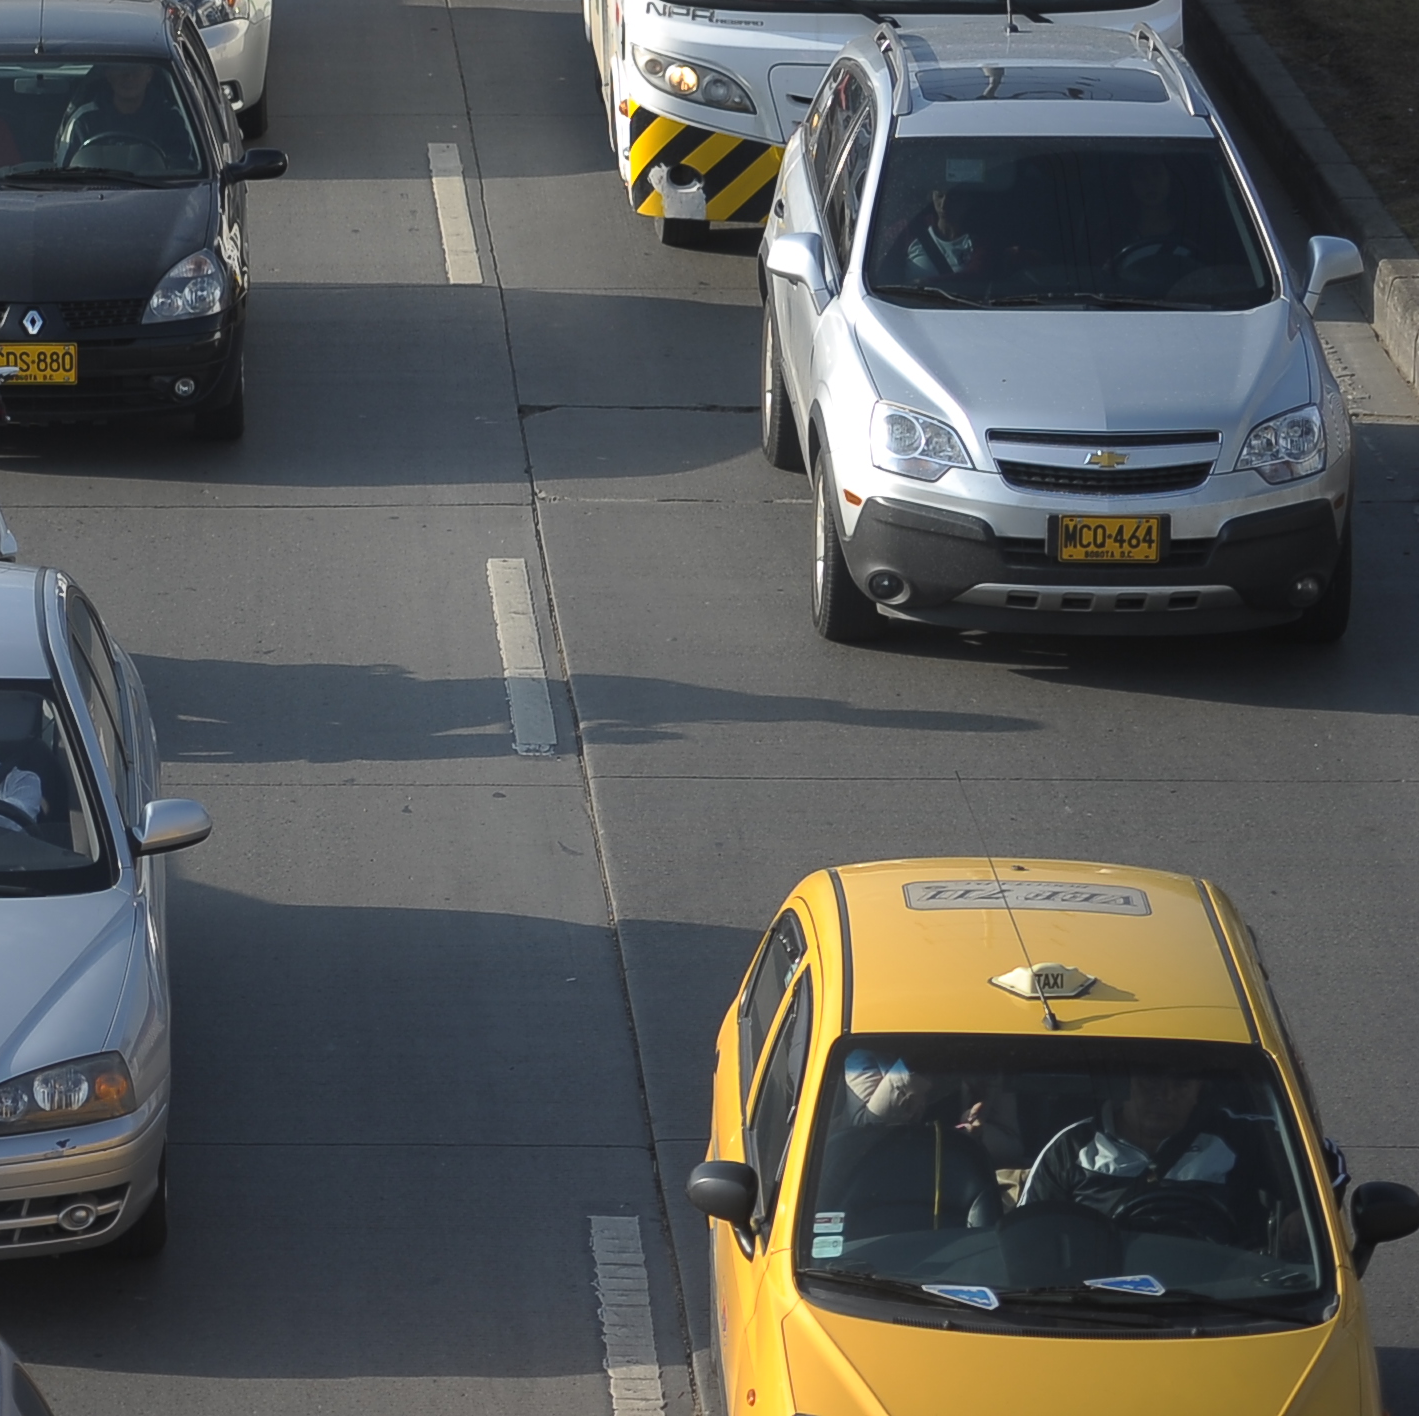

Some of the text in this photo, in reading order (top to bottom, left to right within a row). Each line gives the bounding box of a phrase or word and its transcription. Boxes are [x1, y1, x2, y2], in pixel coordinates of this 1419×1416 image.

[645, 2, 715, 23] NPR
[1084, 550, 1116, 560] BOGOTA
[1034, 972, 1065, 990] TAXI
